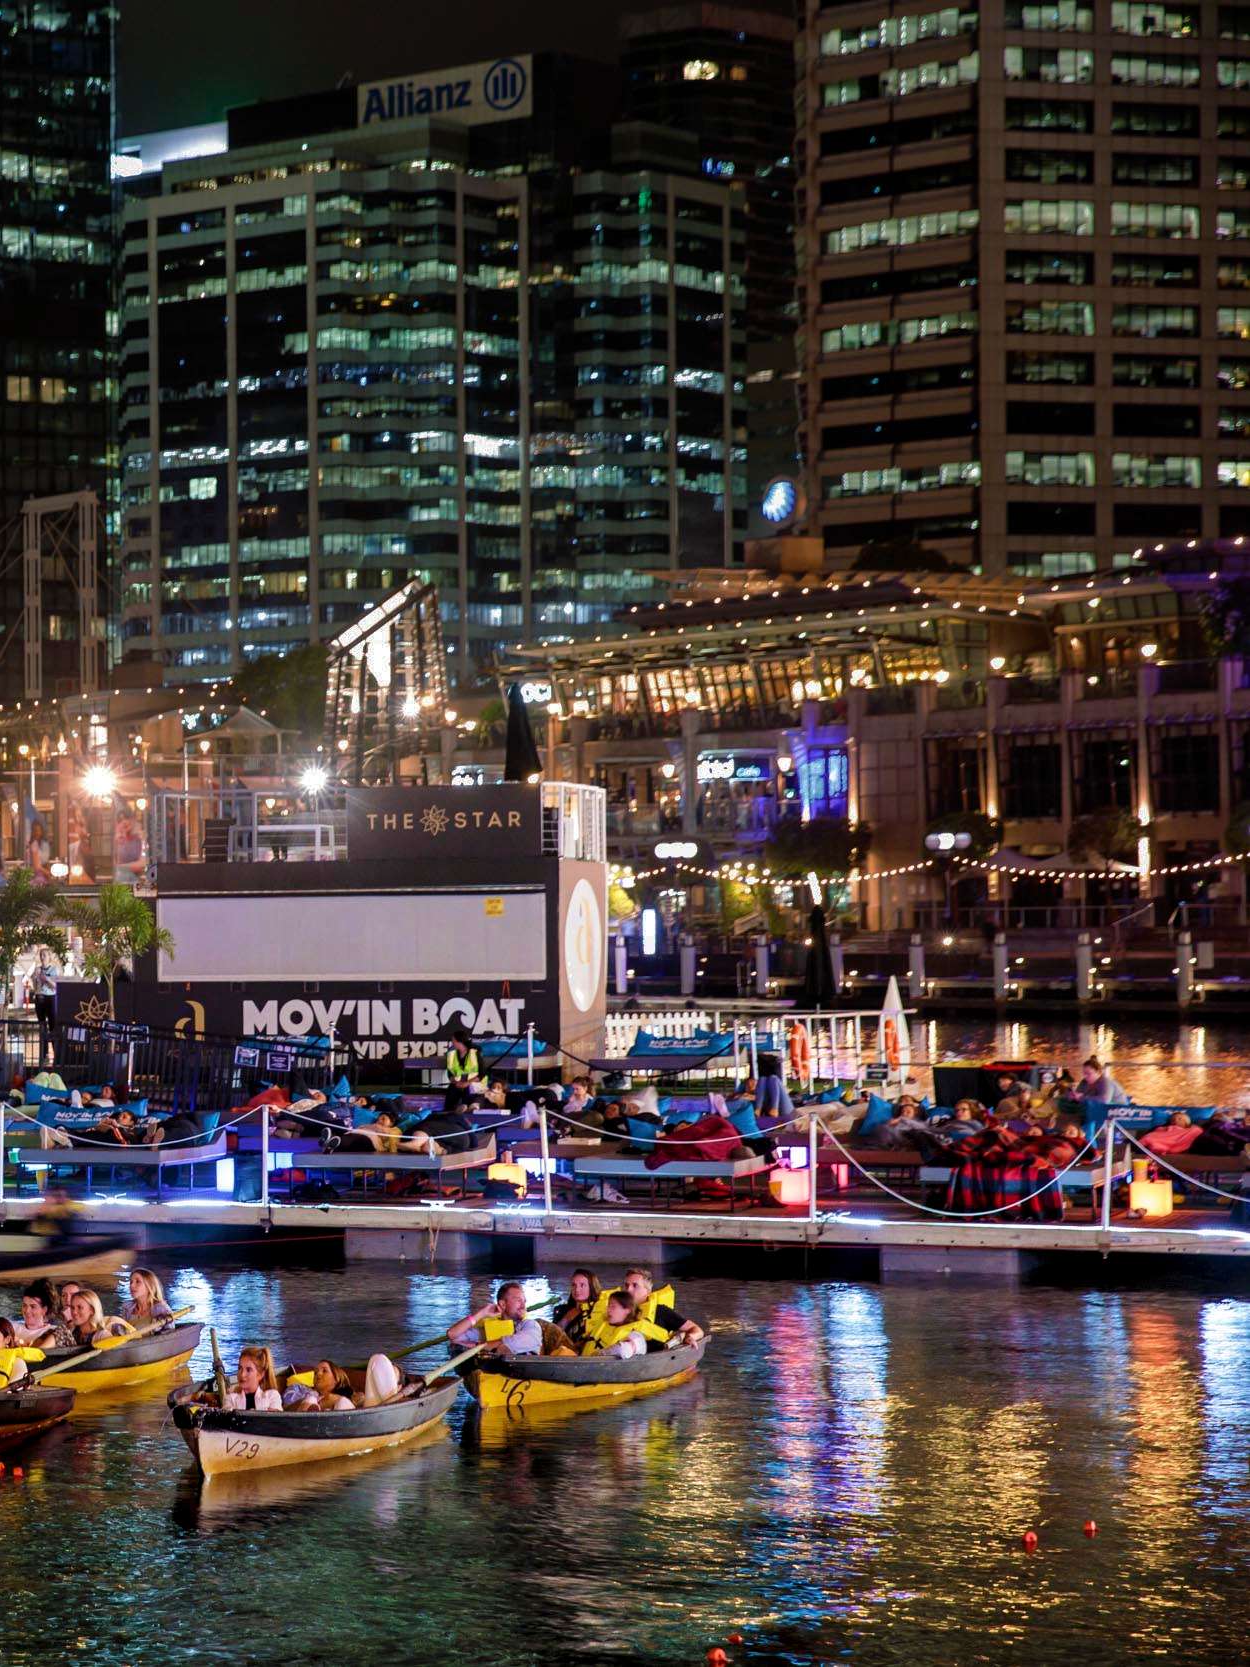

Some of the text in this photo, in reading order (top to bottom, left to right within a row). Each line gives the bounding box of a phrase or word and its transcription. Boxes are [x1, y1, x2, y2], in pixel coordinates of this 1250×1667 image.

[362, 82, 472, 124] Allianz
[366, 811, 522, 831] THE STAR
[243, 998, 525, 1036] MOV'IN BOAT
[353, 1041, 390, 1060] VIP
[225, 1437, 260, 1459] V29
